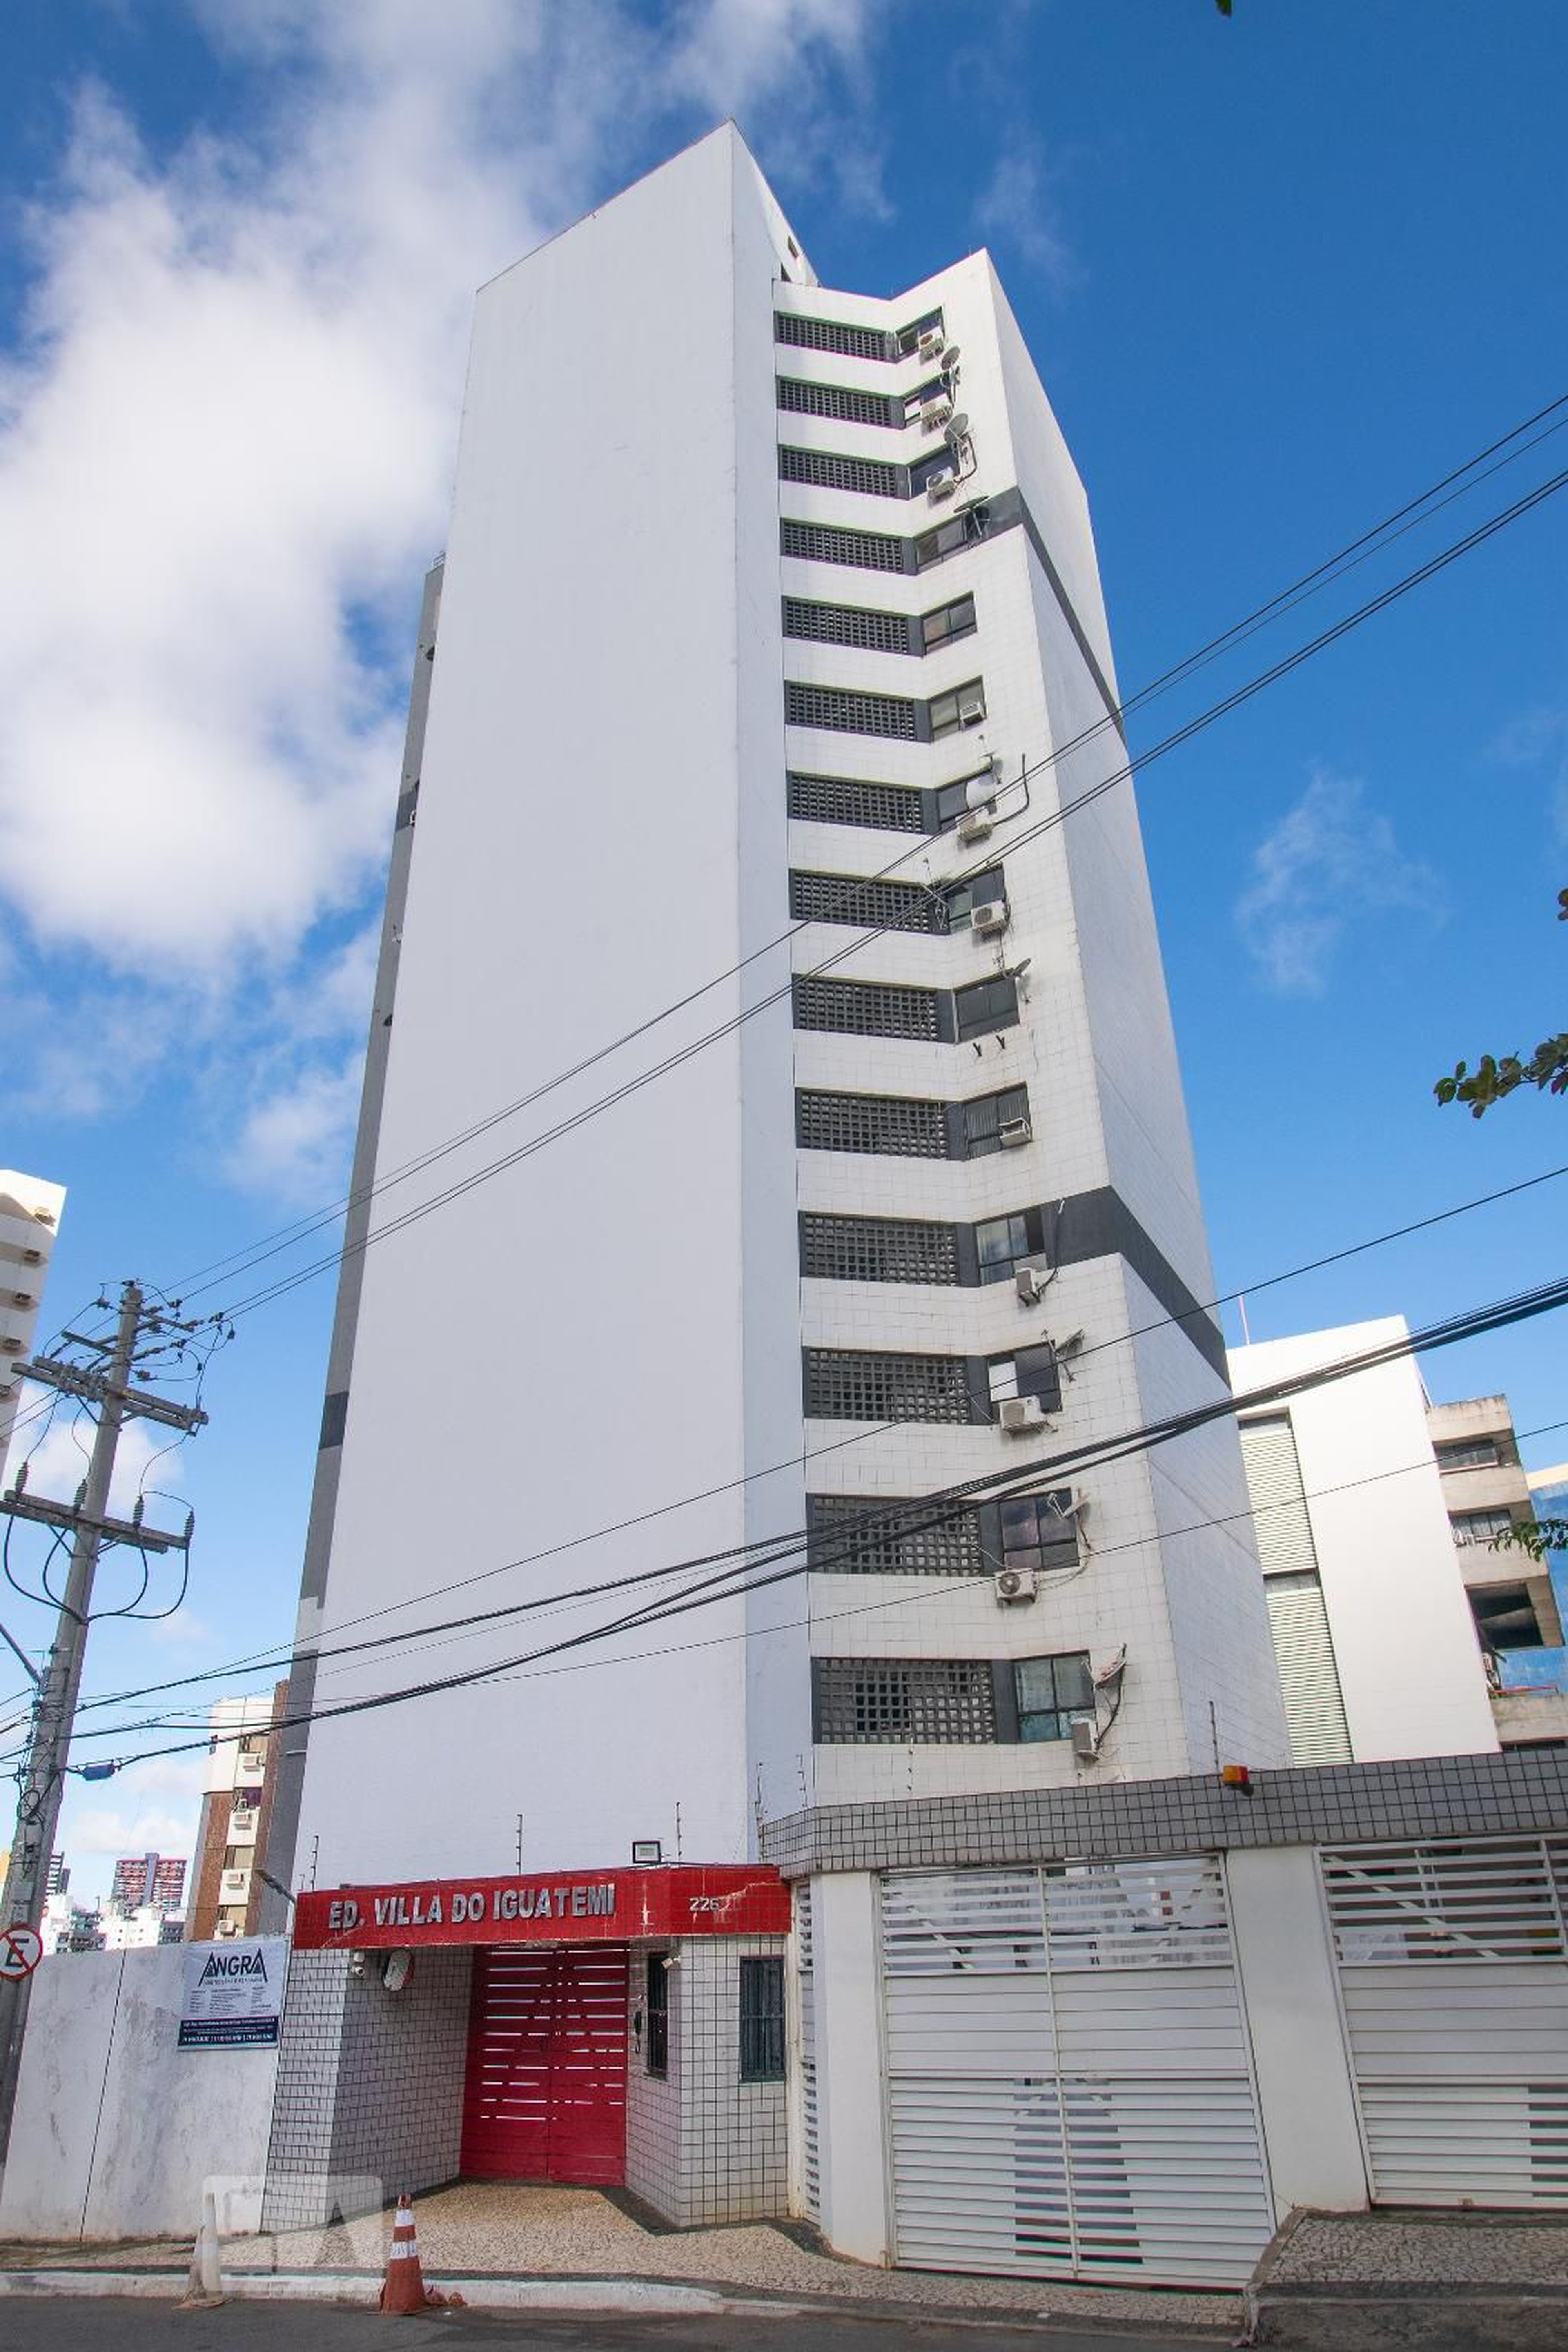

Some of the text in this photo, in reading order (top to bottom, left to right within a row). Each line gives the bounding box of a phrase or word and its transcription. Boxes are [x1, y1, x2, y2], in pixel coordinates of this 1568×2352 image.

[329, 1883, 615, 1929] ED. VILLA DO IGUATEMI
[690, 1897, 719, 1911] 226
[198, 1947, 268, 1987] ANGRA
